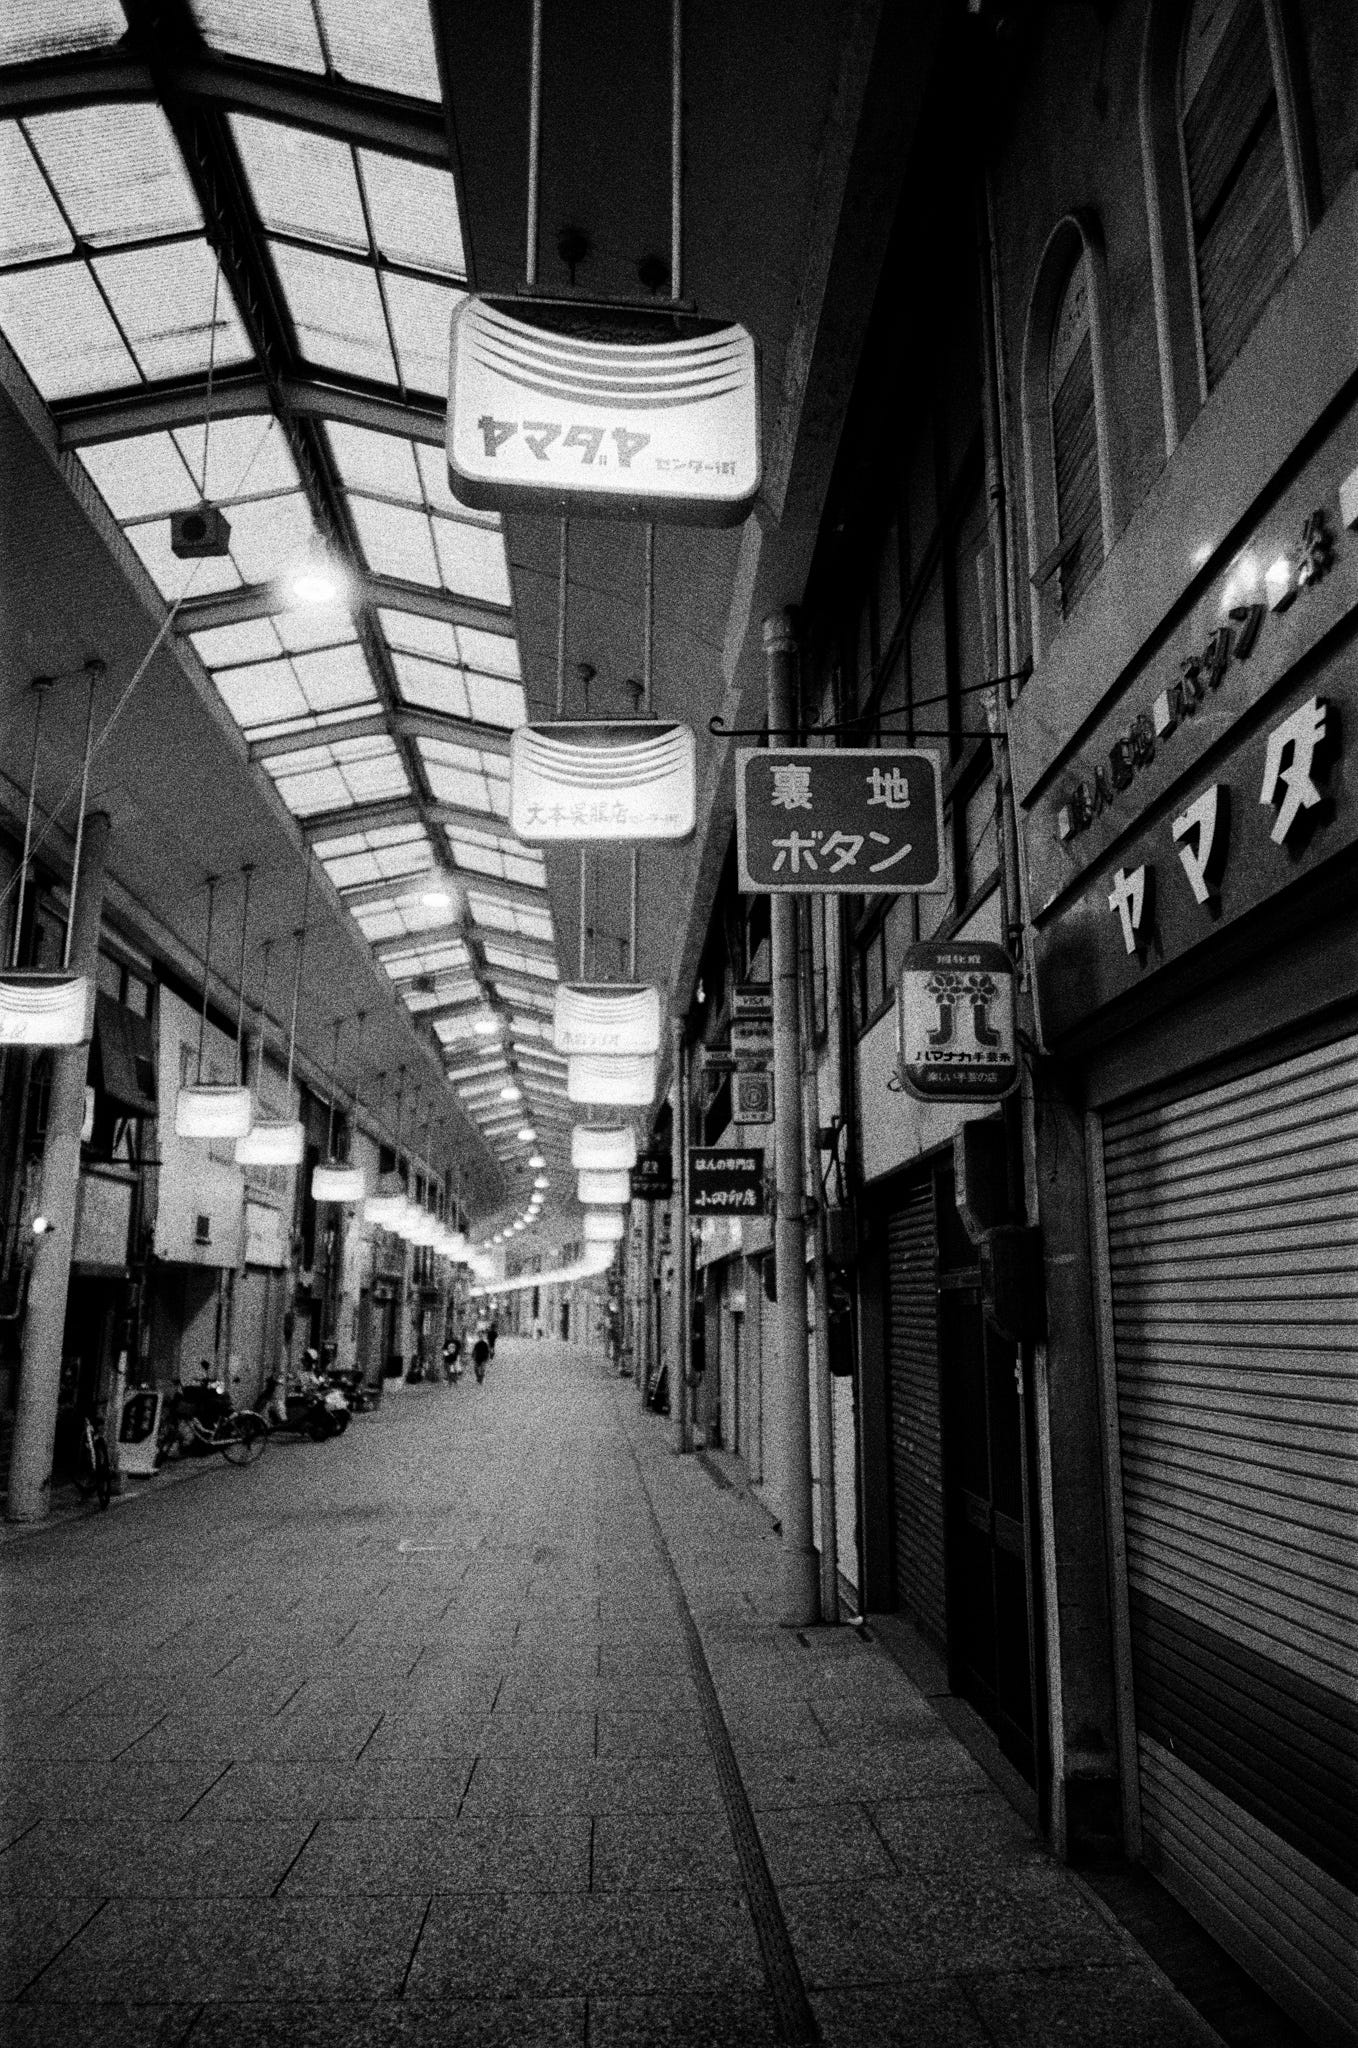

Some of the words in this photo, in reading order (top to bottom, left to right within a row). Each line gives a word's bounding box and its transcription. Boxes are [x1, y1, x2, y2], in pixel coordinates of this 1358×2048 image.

[769, 763, 911, 810] 裏地
[771, 829, 913, 873] ボタン
